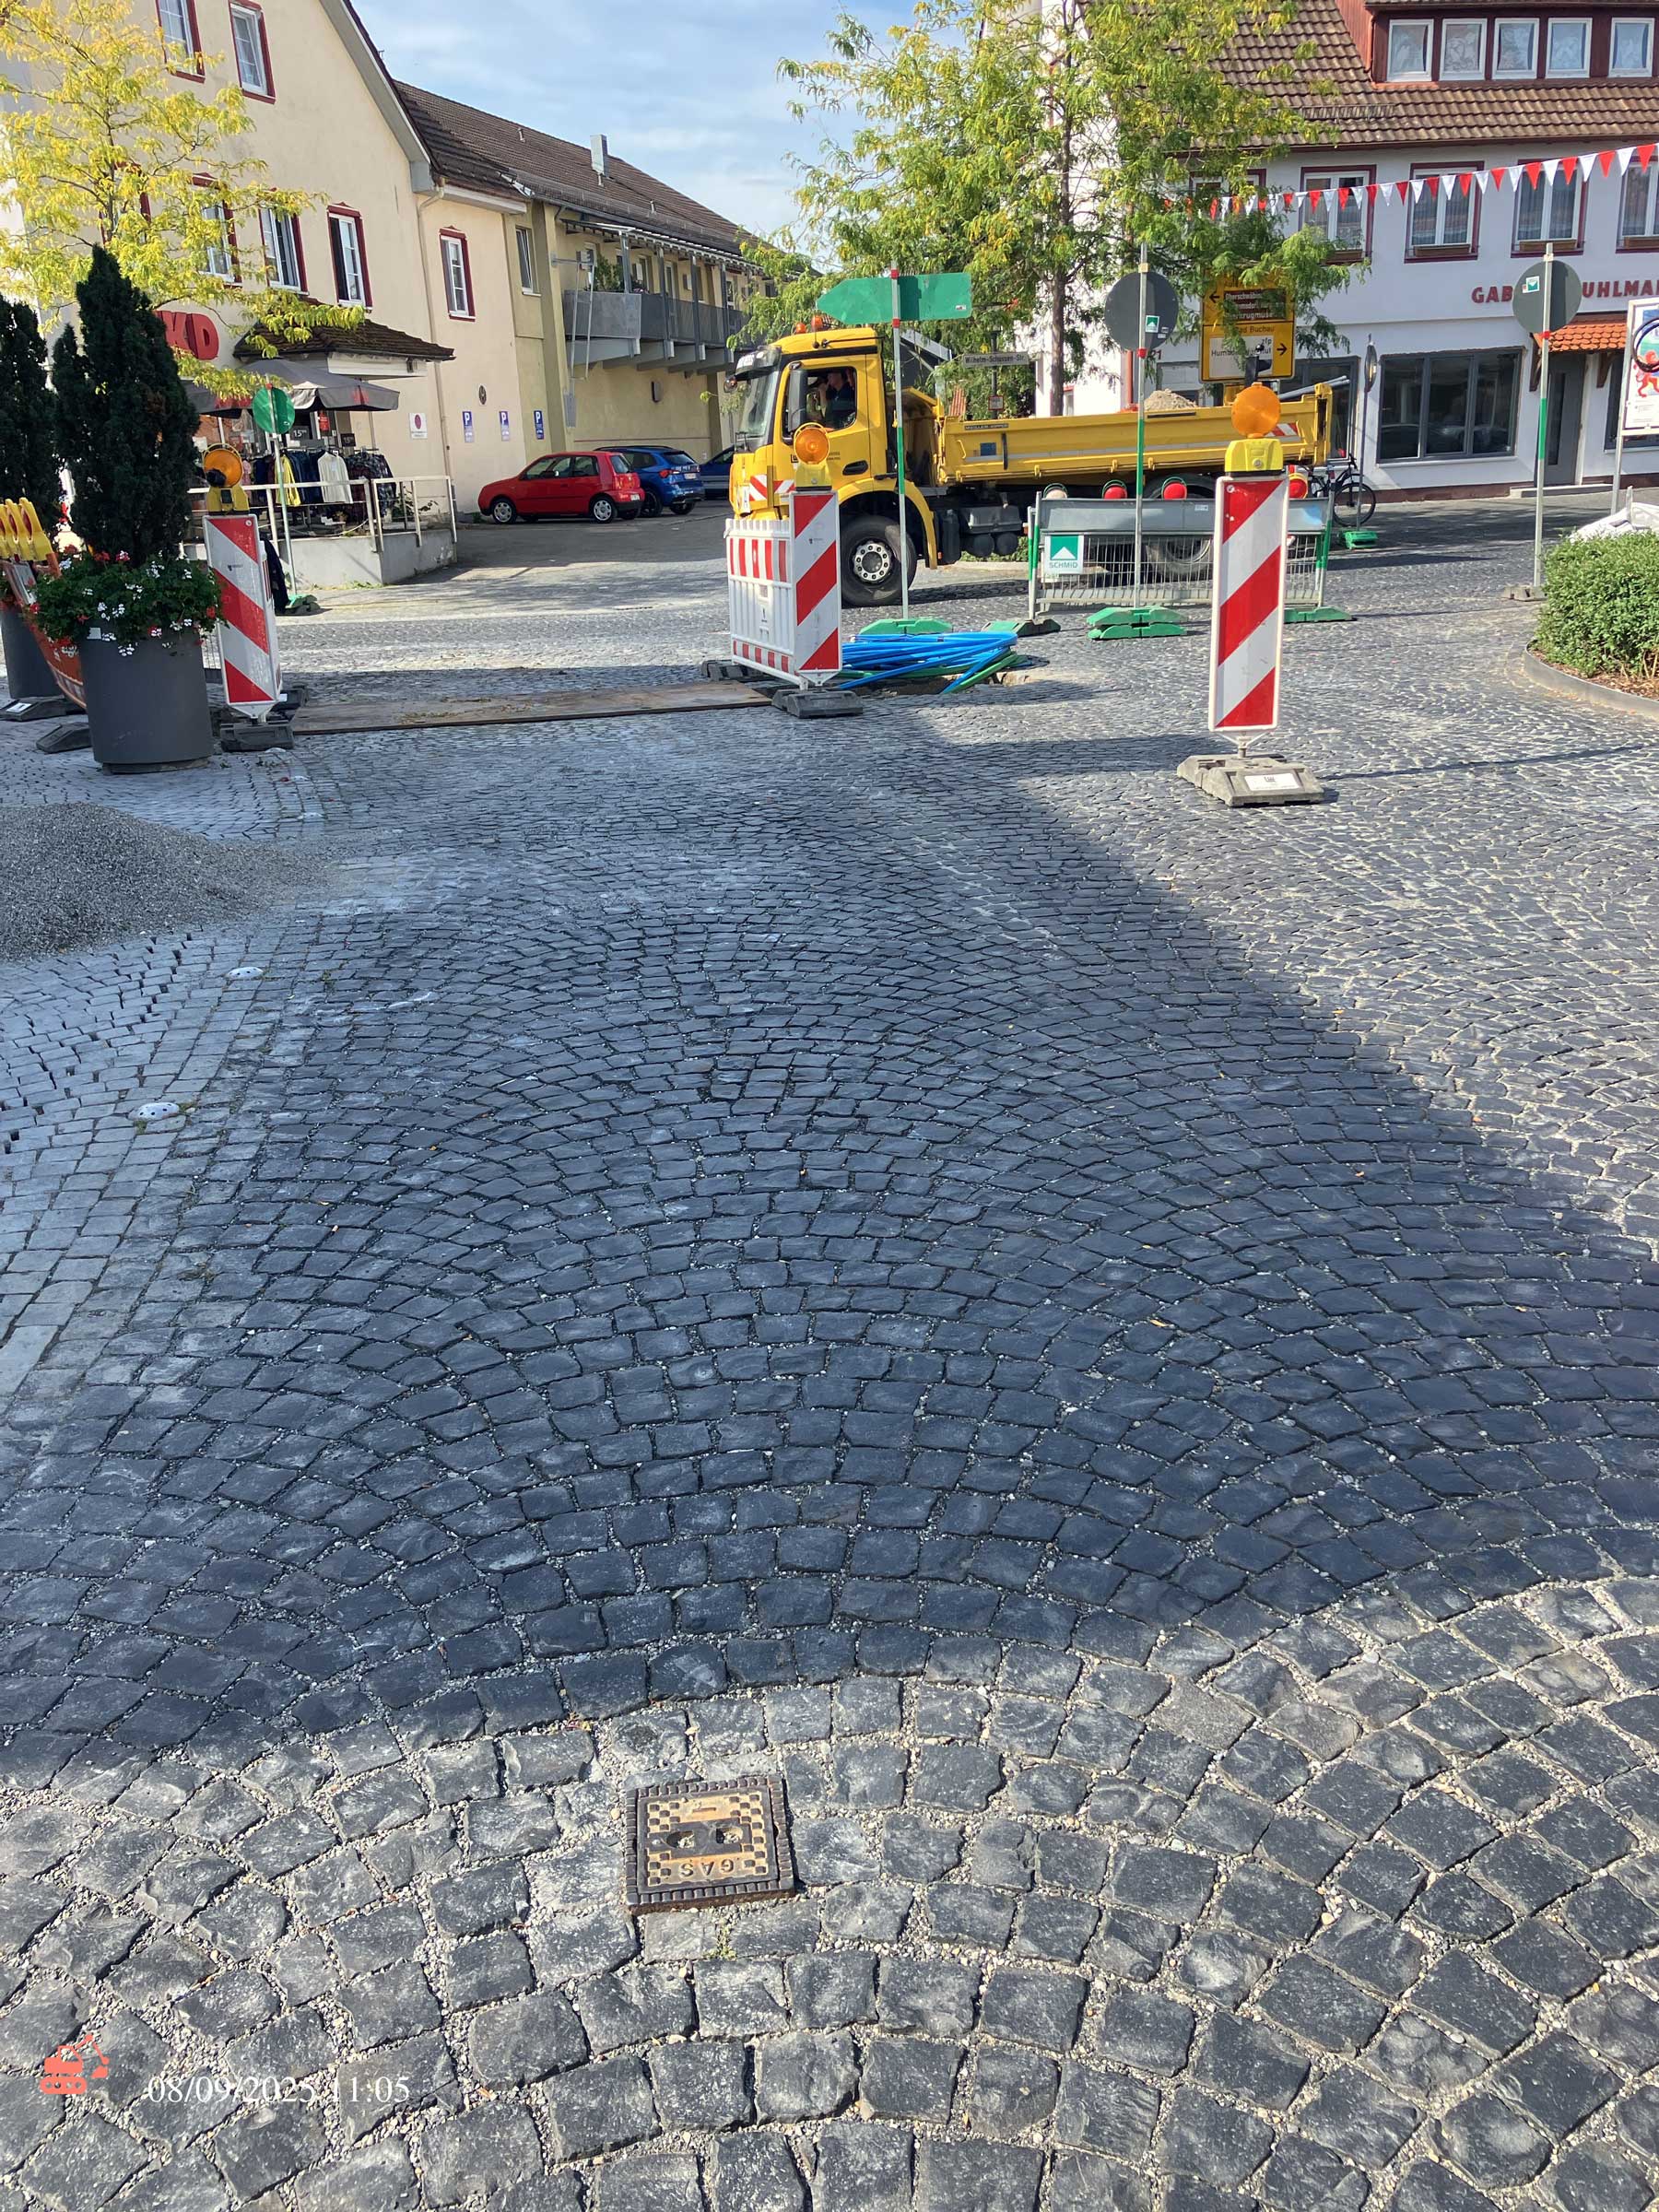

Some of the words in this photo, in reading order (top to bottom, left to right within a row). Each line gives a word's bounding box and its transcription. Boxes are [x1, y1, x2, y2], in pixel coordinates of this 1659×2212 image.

[1471, 286, 1513, 303] GAB
[1582, 278, 1659, 299] UHLMA
[156, 310, 219, 360] KD
[1250, 324, 1276, 333] Buchau
[680, 1858, 735, 1877] GAS
